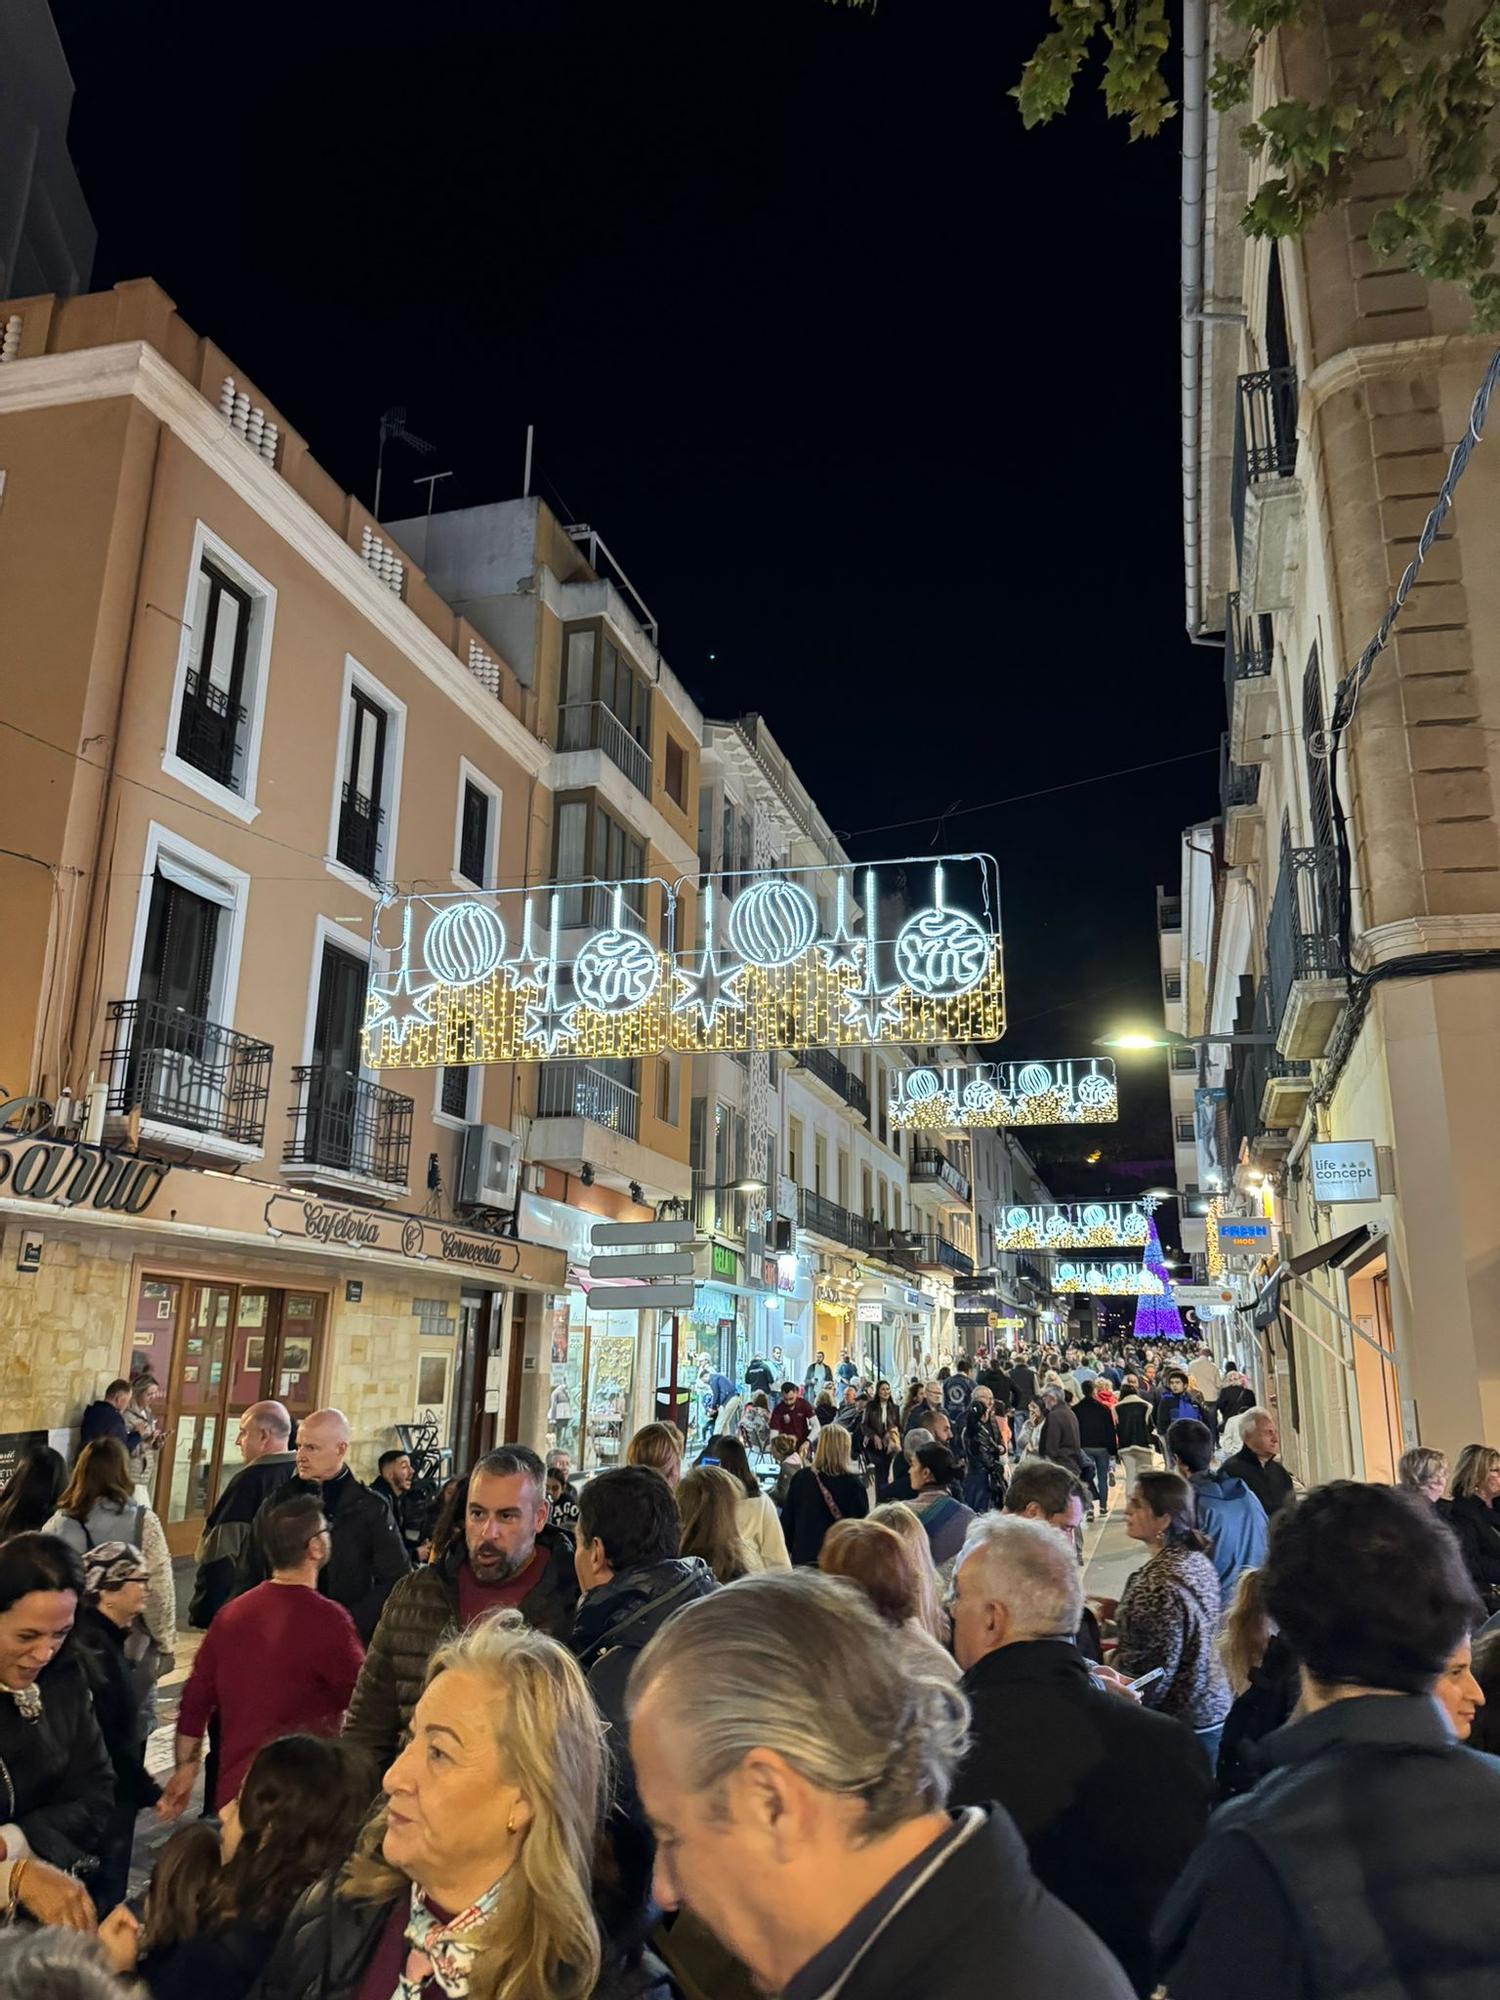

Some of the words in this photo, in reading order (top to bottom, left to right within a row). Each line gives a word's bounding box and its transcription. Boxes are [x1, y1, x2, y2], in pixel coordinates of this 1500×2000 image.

[1315, 1160, 1337, 1171] life
[1316, 1168, 1373, 1184] concept
[303, 1201, 380, 1244] Cafetería
[441, 1230, 502, 1265] Cervecería
